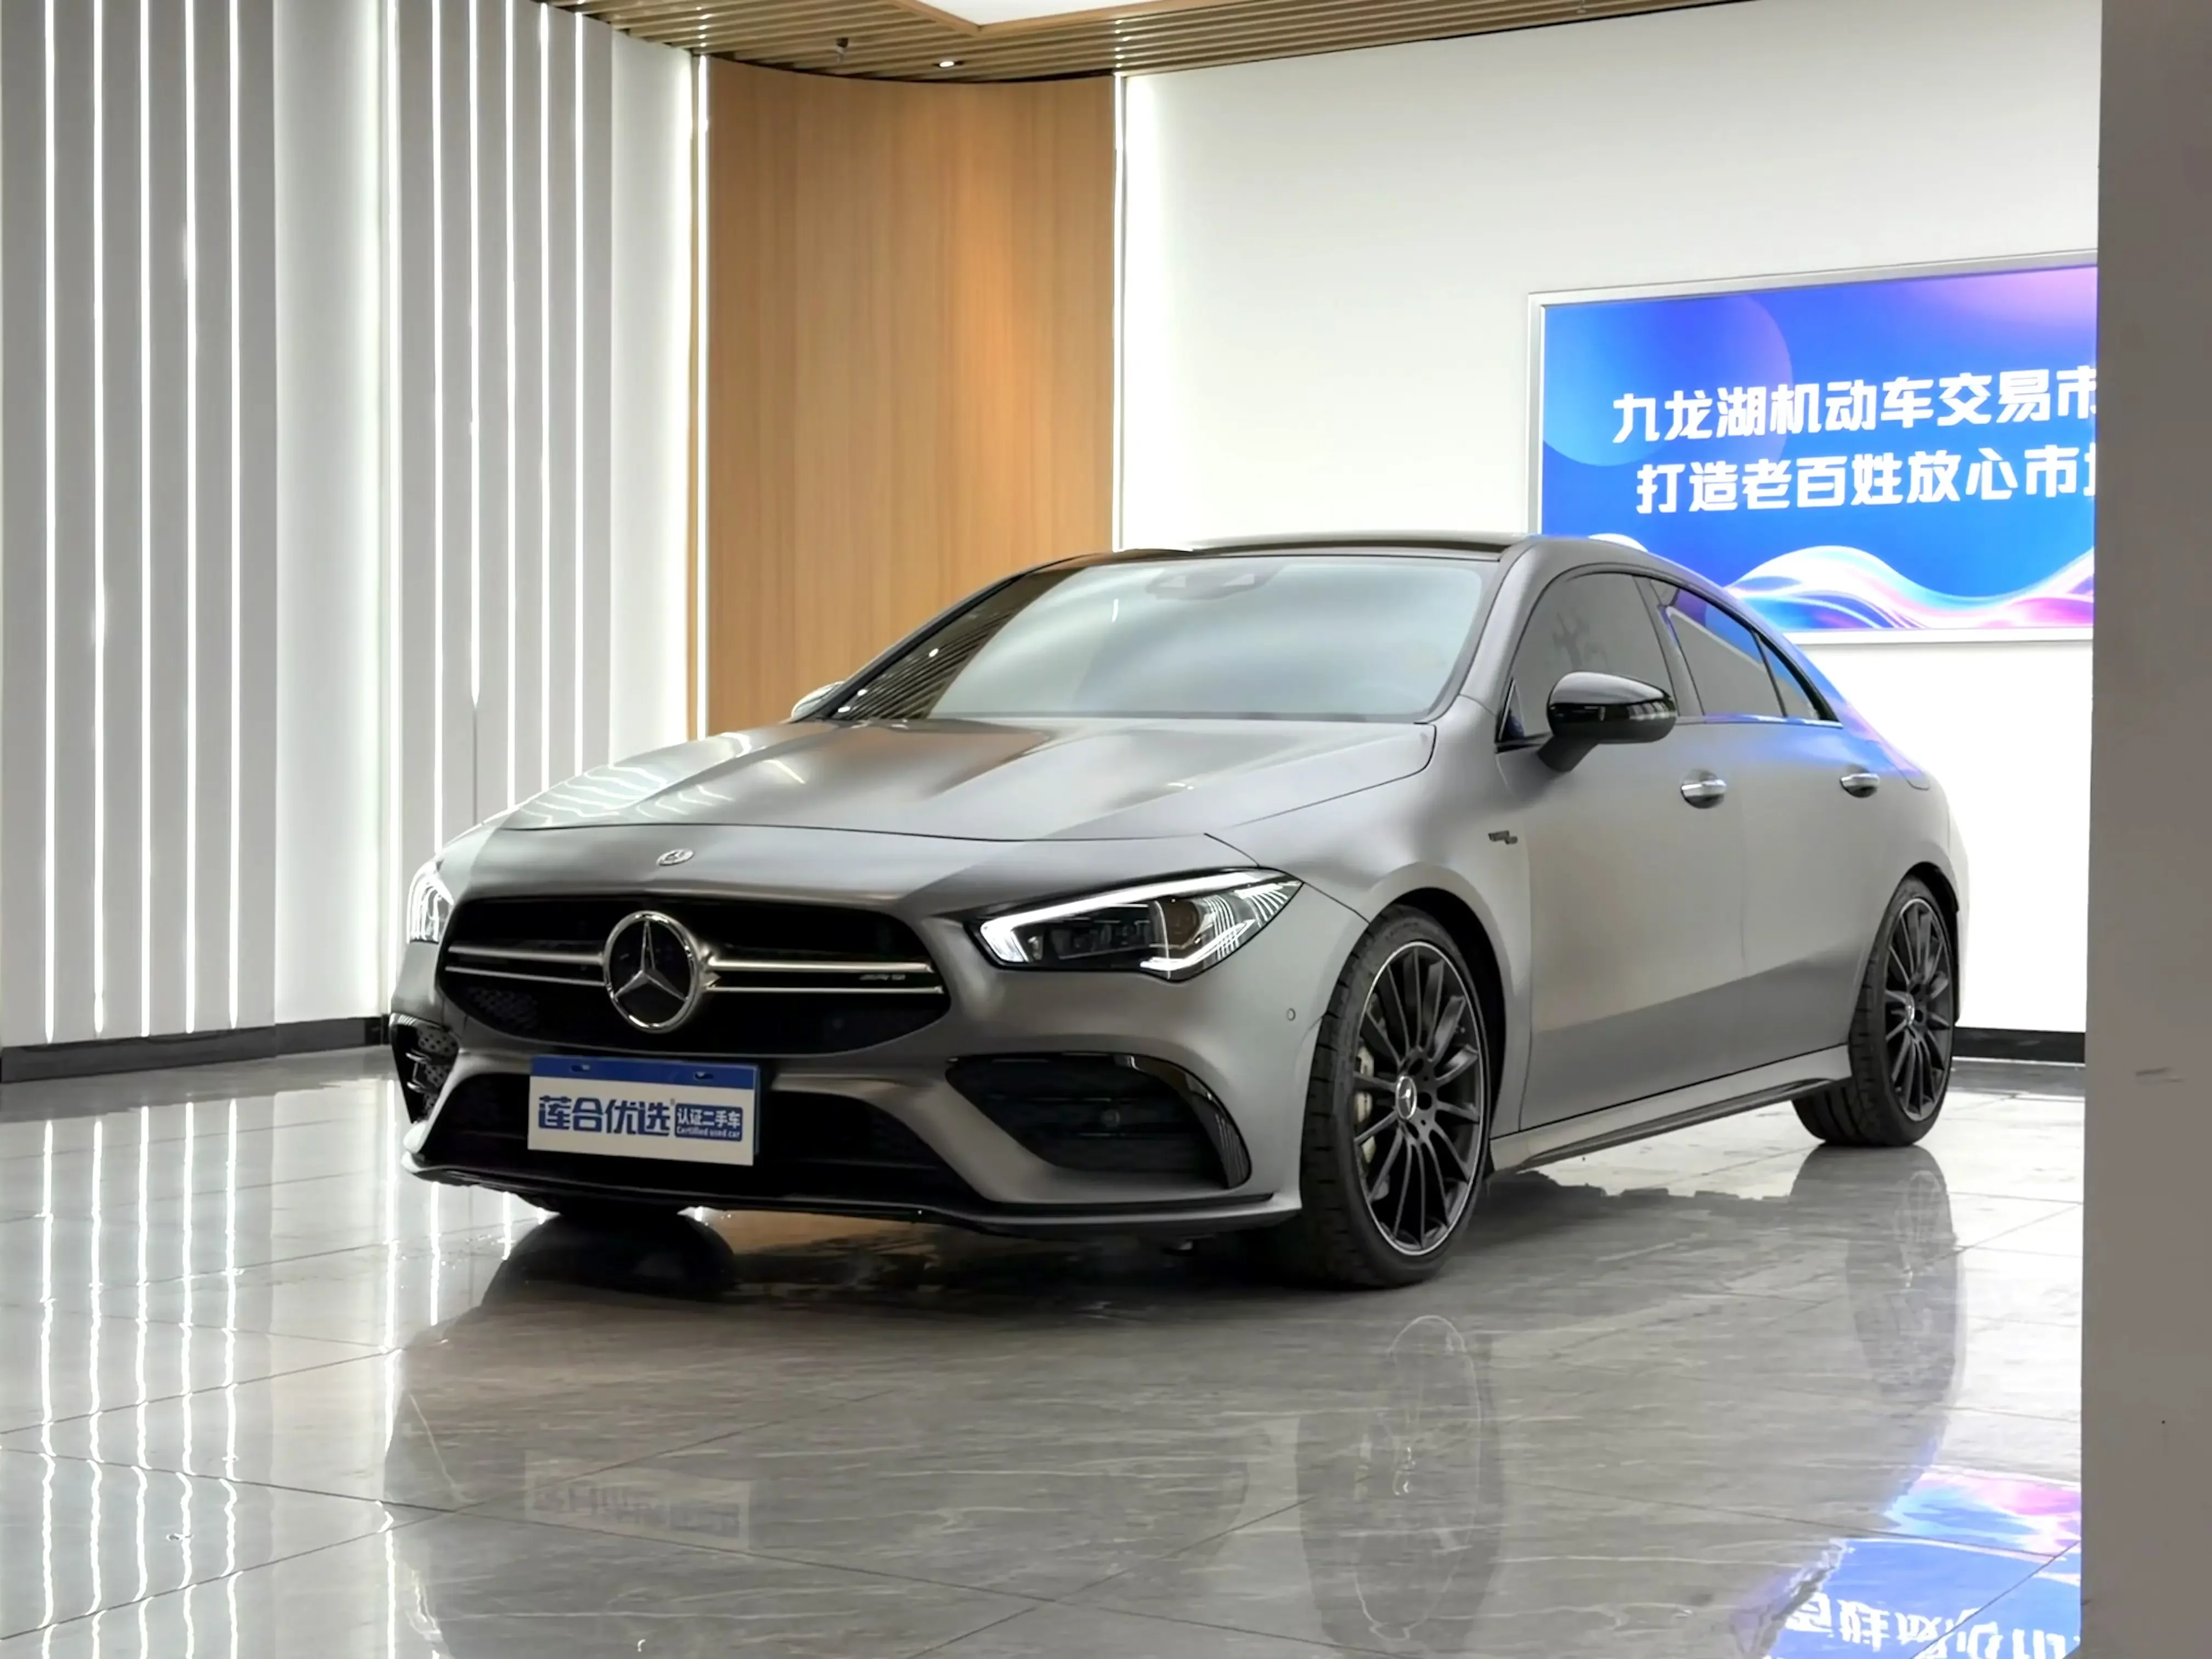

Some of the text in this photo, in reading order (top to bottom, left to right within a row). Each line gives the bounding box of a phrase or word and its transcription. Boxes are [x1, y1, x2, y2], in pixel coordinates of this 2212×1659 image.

[1612, 365, 2096, 443] 九龙湖机动车交易市
[1636, 442, 2096, 514] 打造老百姓放心市
[677, 1107, 741, 1129] 认证二手车
